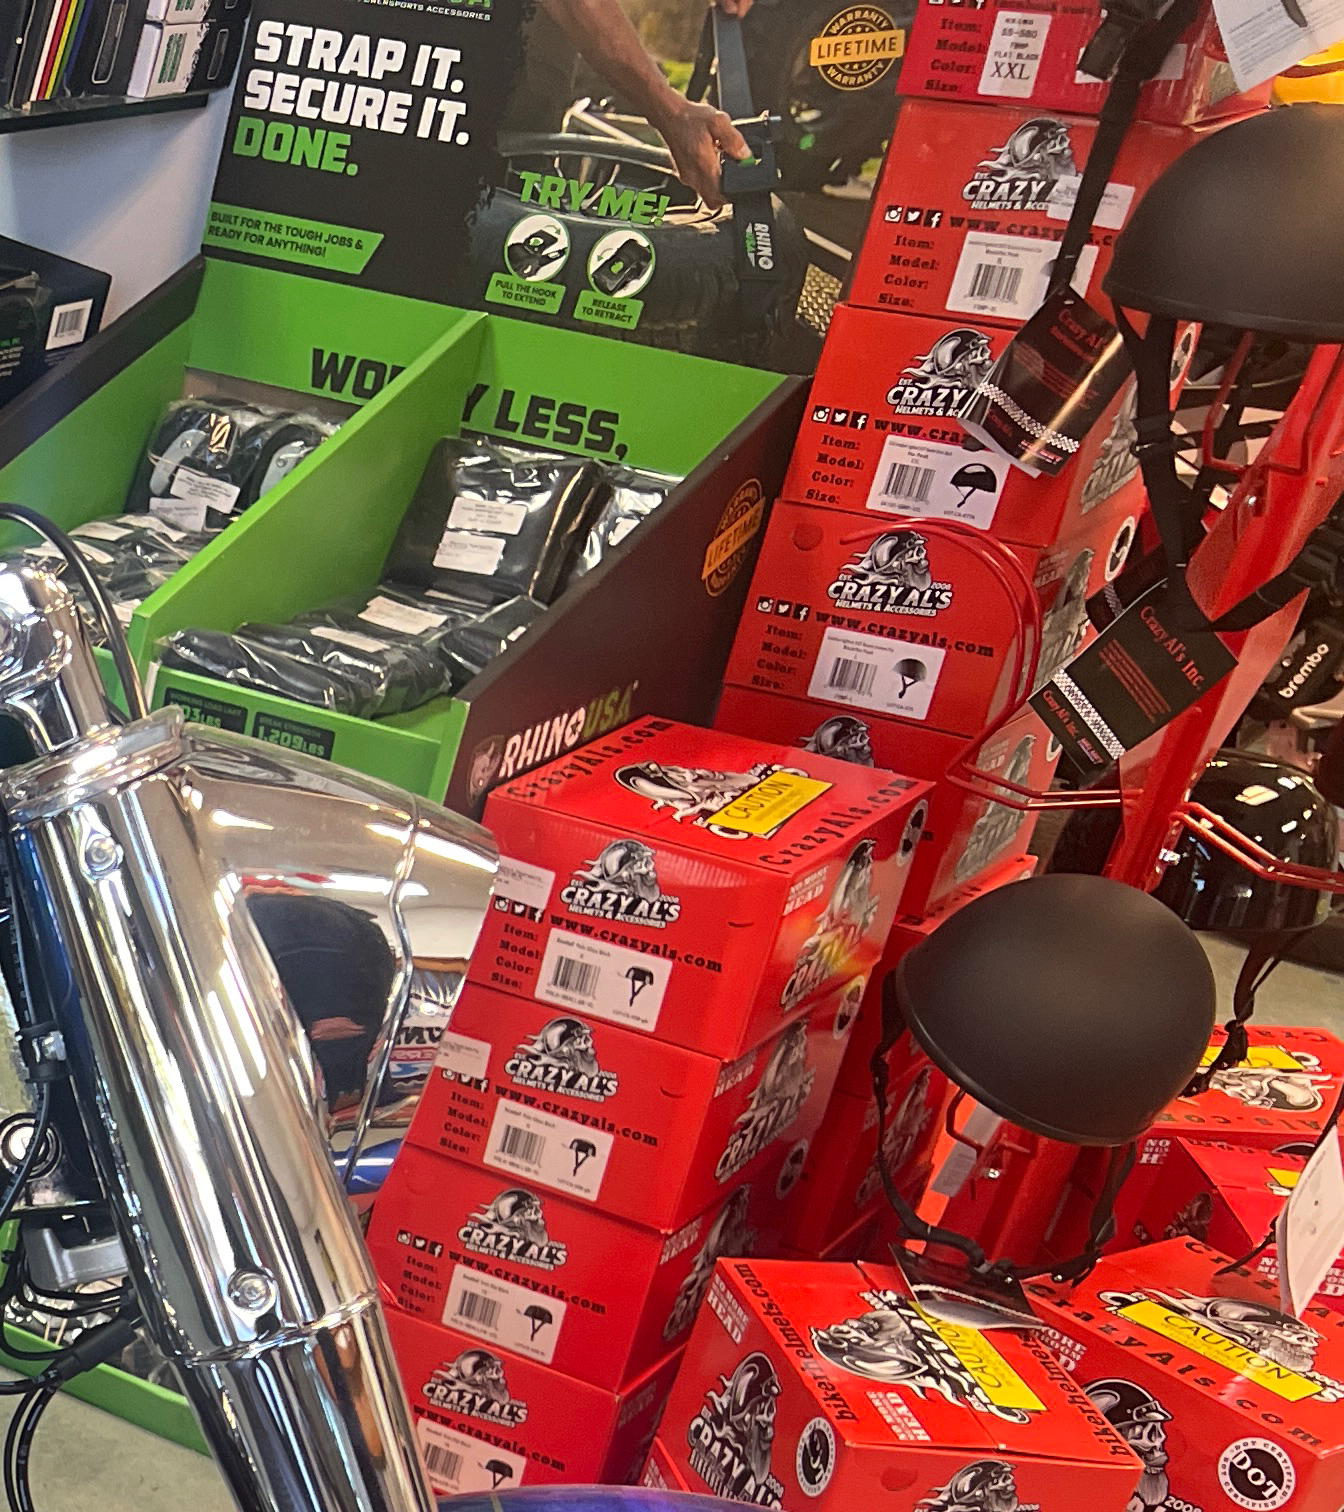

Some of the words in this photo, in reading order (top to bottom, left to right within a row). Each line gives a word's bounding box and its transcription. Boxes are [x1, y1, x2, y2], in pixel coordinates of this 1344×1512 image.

[425, 5, 492, 21] ACCESSORIES
[829, 8, 890, 35] WARRANTY
[254, 20, 407, 80] STRAP
[411, 45, 465, 94] IT.
[817, 36, 898, 60] LIFETIME
[826, 61, 885, 86] WARRANTY
[989, 61, 1031, 81] XXL
[244, 69, 413, 135] SECURE
[416, 97, 470, 146] IT.
[233, 116, 359, 177] DONE.
[519, 170, 594, 213] TRY
[597, 185, 670, 228] ME!
[962, 180, 1047, 202] CRAZY
[971, 200, 1012, 211] HELMETS
[208, 224, 243, 242] READY
[243, 231, 265, 246] FOR
[266, 236, 327, 258] ANYTHING!
[211, 210, 239, 227] BUILT
[240, 215, 261, 231] FOR
[264, 220, 282, 236] THE
[285, 225, 323, 242] TOUGH
[324, 233, 353, 248] JOBS
[354, 239, 364, 250] &
[894, 234, 935, 250] Item:
[889, 254, 939, 271] Model:
[496, 280, 513, 291] PULL
[515, 283, 530, 294] THE
[531, 287, 557, 299] HOOK
[883, 273, 929, 290] Color:
[502, 290, 513, 301] TO
[514, 293, 546, 306] EXTEND
[592, 298, 627, 312] RELEASE
[582, 307, 594, 317] TO
[595, 310, 633, 324] RETRACT
[886, 386, 968, 407] CRAZY
[895, 404, 935, 417] HELMETS
[494, 389, 629, 462] LESS,
[822, 434, 862, 451] Item:
[816, 452, 865, 470] Model:
[812, 471, 855, 488] Color:
[806, 489, 841, 505] Size:
[828, 580, 900, 606] CRAZY
[901, 586, 953, 611] AL'S
[835, 600, 873, 613] HELMETS
[884, 605, 937, 617] ACCESSORIES
[815, 610, 995, 658] www.crazyals.com
[1278, 643, 1329, 699] brembo
[499, 706, 586, 779] RHINO
[507, 720, 673, 798] CrazyAls.com
[724, 779, 795, 821] CAUTION
[758, 778, 920, 866] CrazyAls.com
[561, 884, 627, 917] CRAZY
[633, 895, 681, 923] AL'S
[503, 922, 538, 942] Item:
[549, 913, 722, 973] www.crazyals.com
[499, 939, 543, 961] Model:
[495, 955, 534, 976] Color:
[504, 1058, 570, 1088] CRAZY
[572, 1070, 619, 1097] AL'S
[446, 1106, 489, 1128] Model:
[494, 1083, 659, 1147] www.crazyals.com
[443, 1121, 481, 1142] Color:
[457, 1226, 524, 1255] CRAZY
[526, 1240, 568, 1266] AL'S
[448, 1251, 606, 1315] www.crazyals.com
[1163, 1314, 1293, 1381] CAUTION
[422, 1382, 486, 1410] CRAZY
[486, 1402, 528, 1424] AL'S
[413, 1404, 566, 1473] www.crazyals.com
[687, 1415, 746, 1480] CRAZY
[1230, 1449, 1280, 1500] DOT
